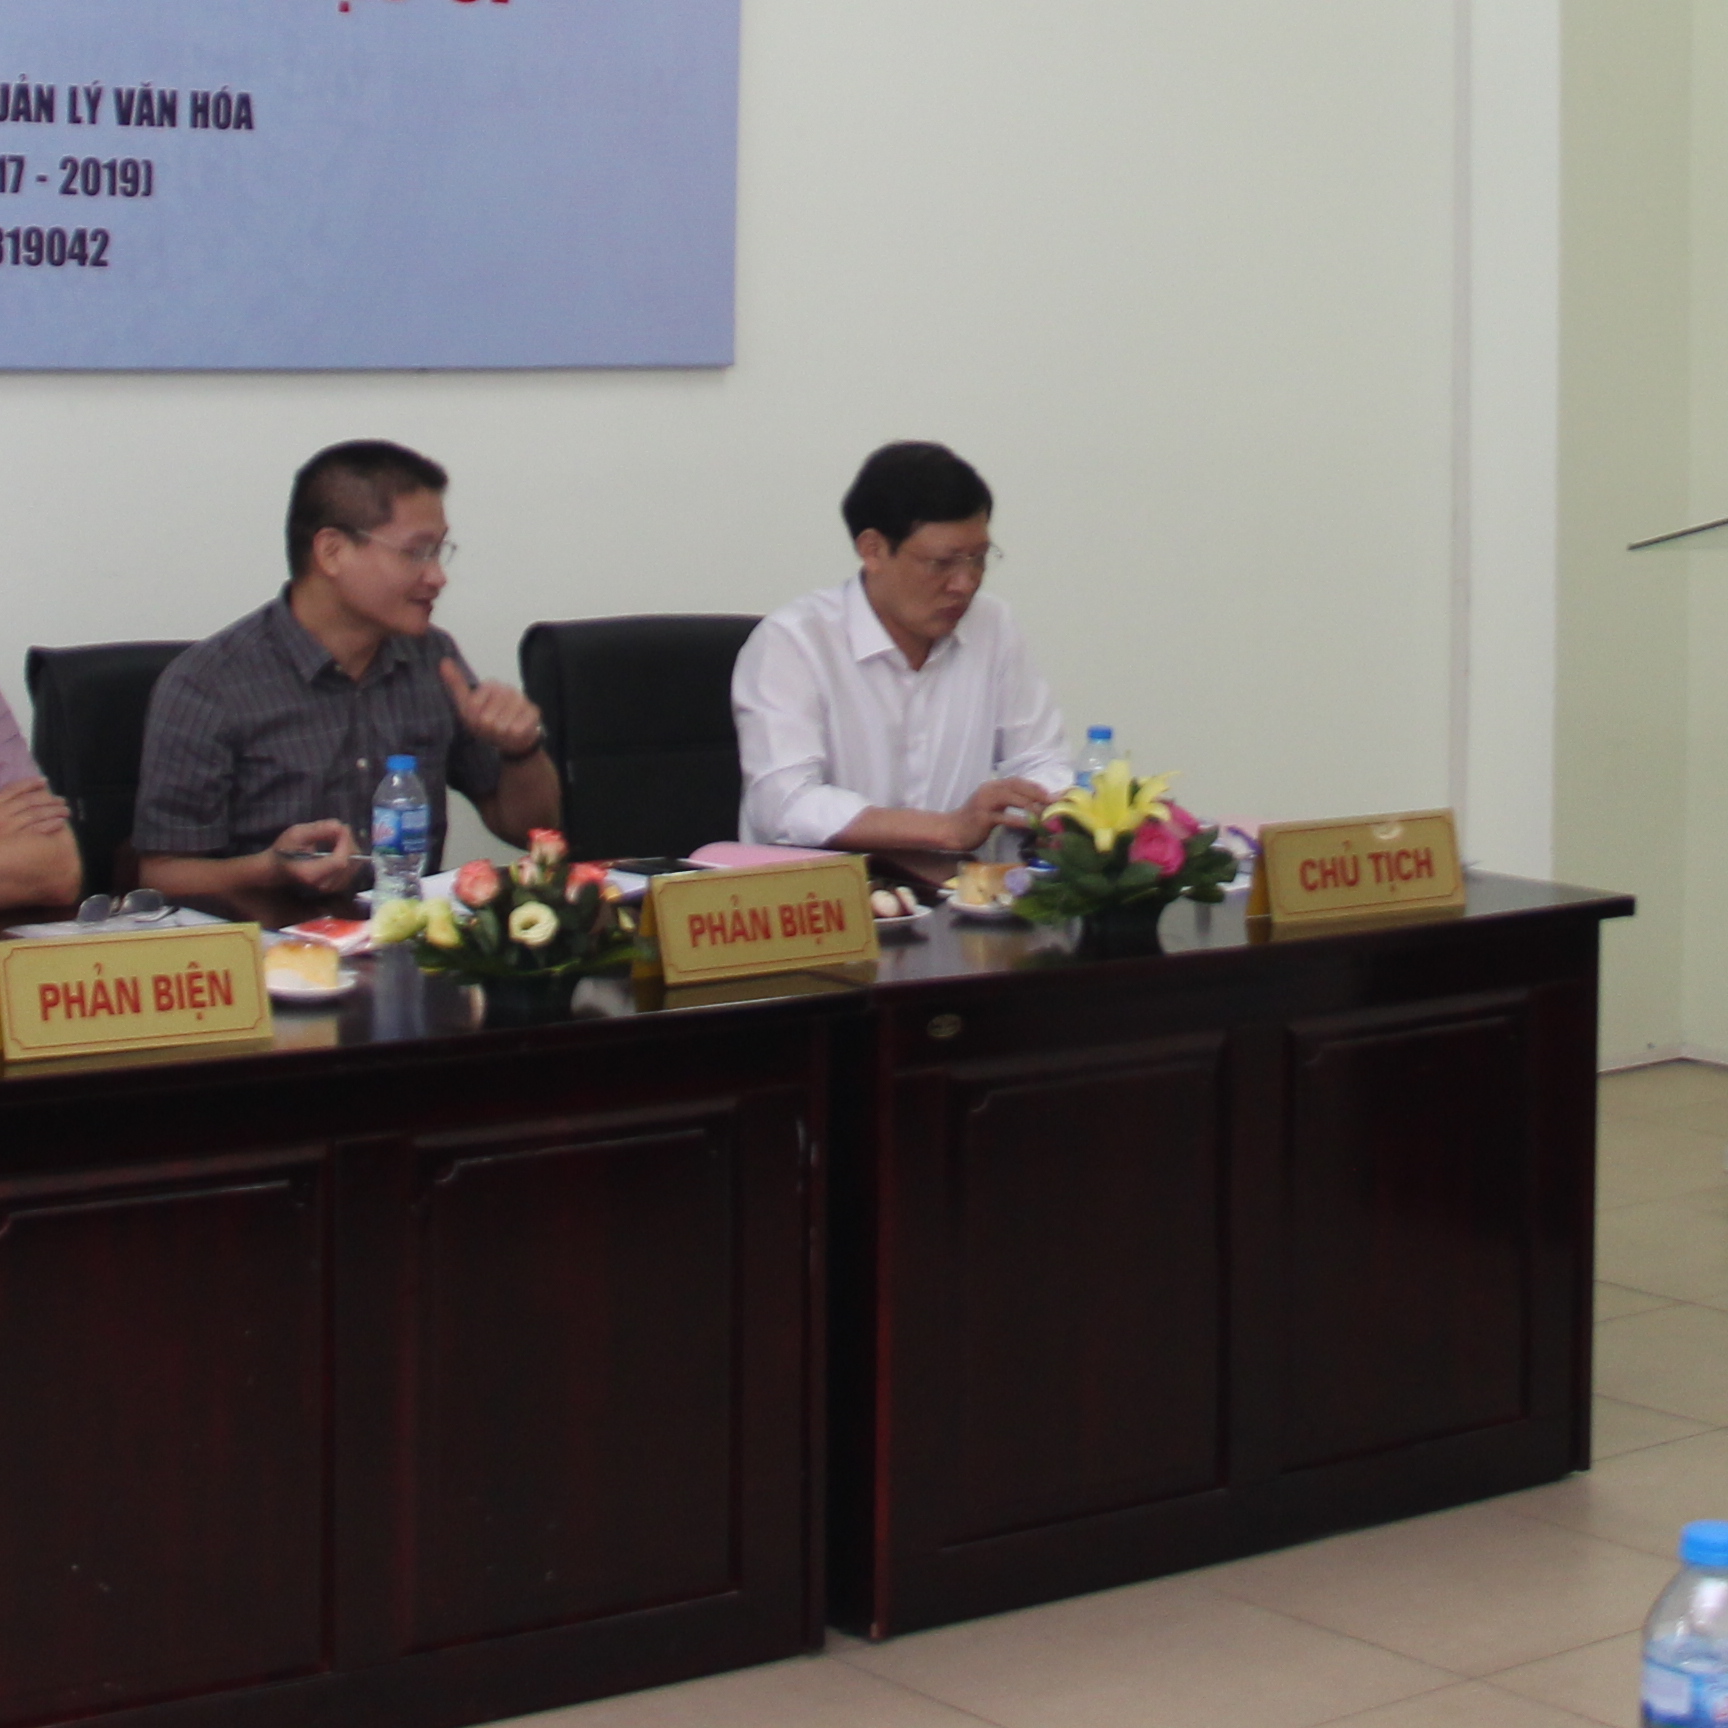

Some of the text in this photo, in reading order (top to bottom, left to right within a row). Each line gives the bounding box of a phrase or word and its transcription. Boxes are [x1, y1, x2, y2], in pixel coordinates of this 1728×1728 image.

[67, 80, 103, 126] LÝ
[114, 81, 178, 128] VĂN
[189, 85, 255, 130] HÓA
[36, 175, 48, 183] -
[1299, 839, 1435, 892] CHỦ TỊCH
[688, 891, 846, 948] PHẢN BIỆN
[39, 961, 234, 1022] PHẢN BIỆN
